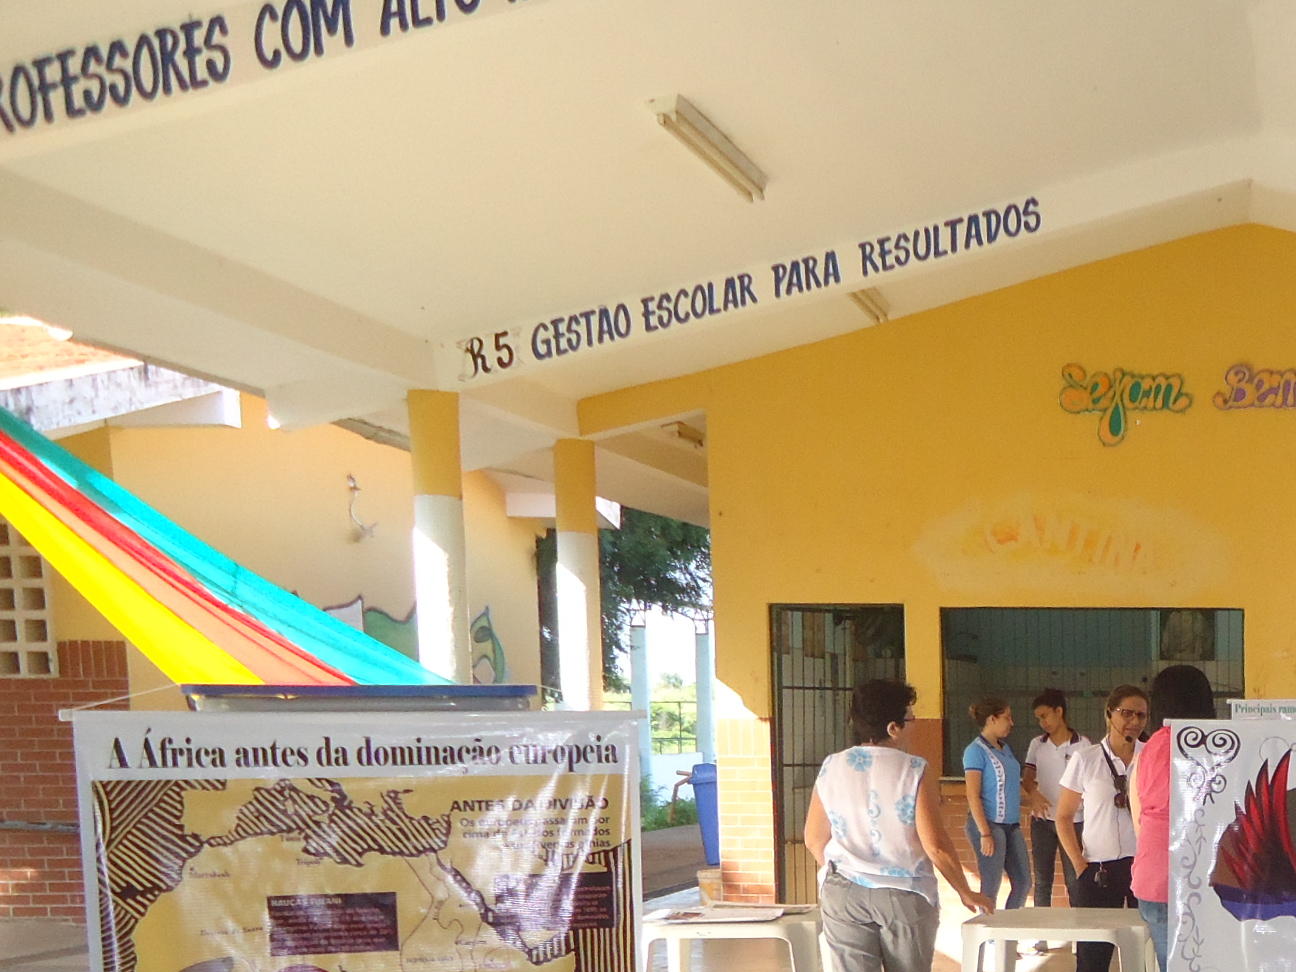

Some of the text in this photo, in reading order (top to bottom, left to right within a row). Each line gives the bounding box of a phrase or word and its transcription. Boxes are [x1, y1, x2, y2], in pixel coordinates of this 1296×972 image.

[254, 0, 355, 69] COM
[640, 273, 759, 333] ESCOLAR
[771, 250, 842, 300] PARA
[857, 197, 1042, 278] RESULTADOS
[1235, 703, 1277, 717] Principais
[107, 727, 619, 775] A África antes da dominação europeia
[512, 799, 537, 812] DA
[543, 795, 609, 811] DIVIÃO
[593, 816, 610, 825] or
